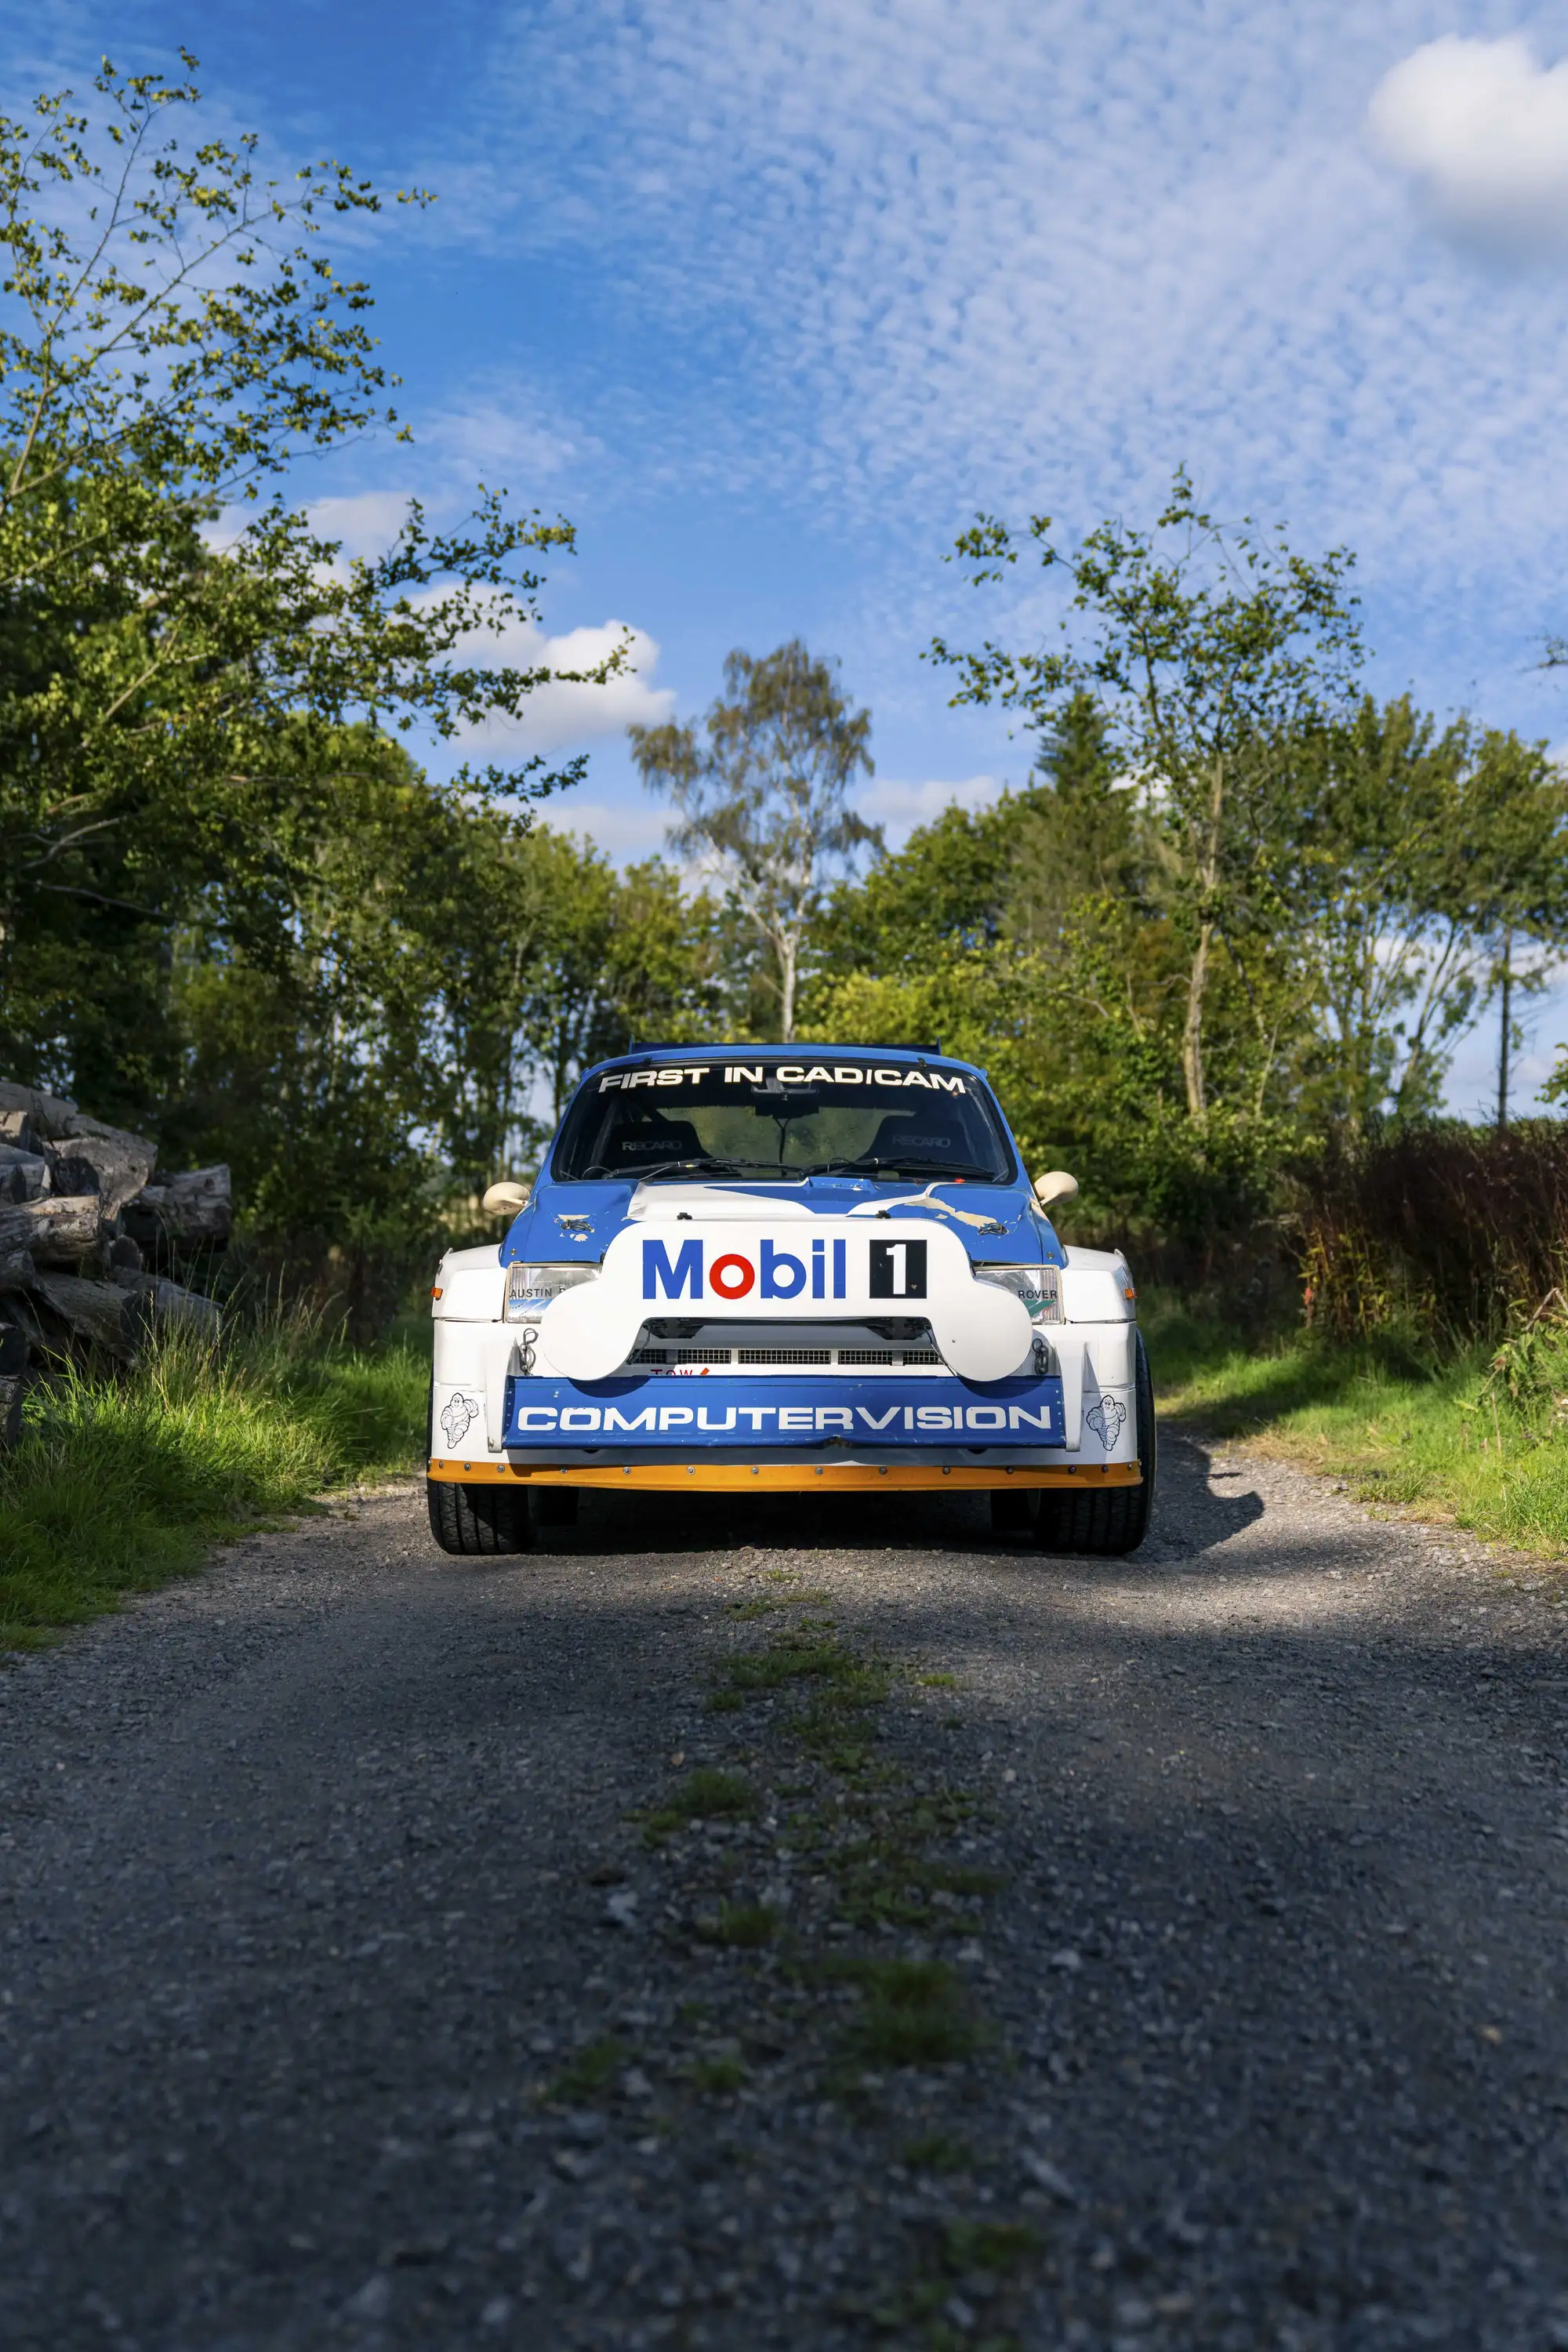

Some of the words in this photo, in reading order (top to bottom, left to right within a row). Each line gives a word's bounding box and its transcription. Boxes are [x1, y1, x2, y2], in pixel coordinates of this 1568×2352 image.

[598, 1068, 710, 1093] FIRST
[724, 1067, 763, 1083] IN
[622, 1140, 682, 1152] RECARO
[892, 1137, 951, 1149] RECARO
[642, 1240, 846, 1299] Mobil
[886, 1243, 906, 1294] 1
[510, 1288, 552, 1298] AUSTIN
[1018, 1290, 1057, 1299] ROVER
[517, 1406, 1051, 1431] COMPUTERVISION
